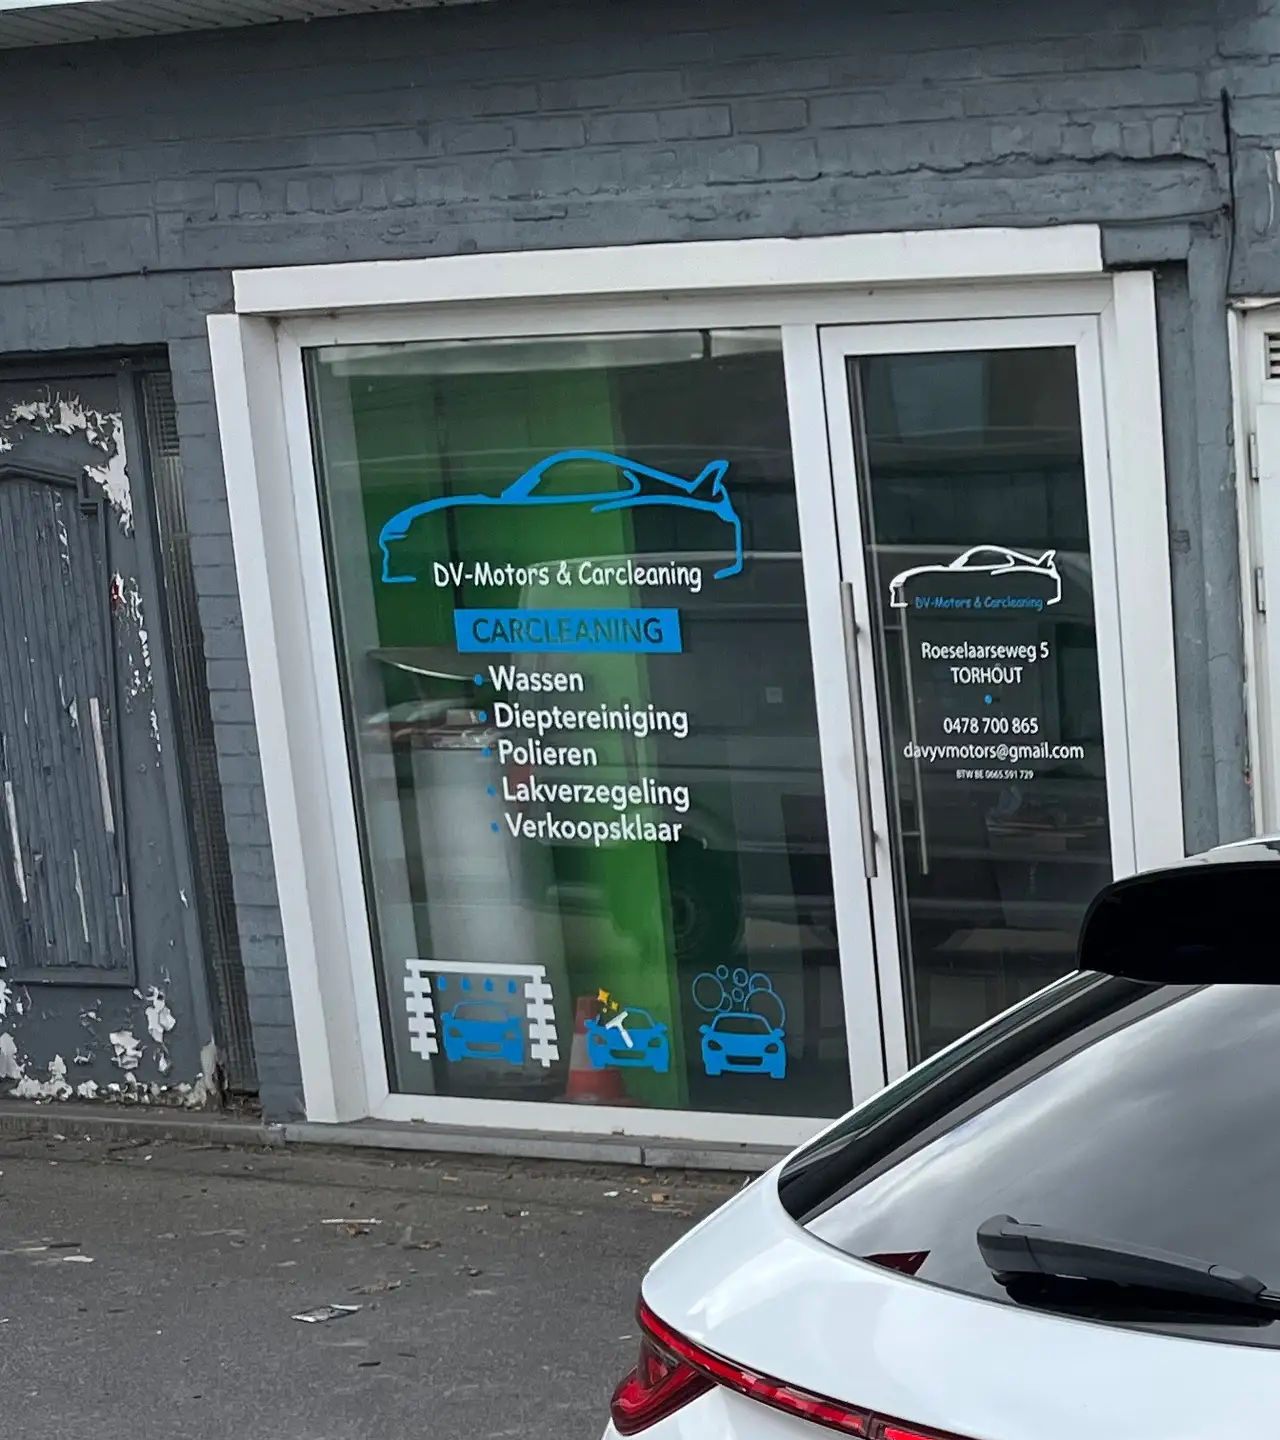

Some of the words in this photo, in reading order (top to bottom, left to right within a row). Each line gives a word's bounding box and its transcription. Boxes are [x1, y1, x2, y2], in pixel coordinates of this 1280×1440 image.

[433, 561, 550, 588] DV-Motors
[556, 562, 571, 586] &
[577, 561, 702, 593] Carcleaning
[915, 596, 971, 609] DV-Motors
[984, 596, 1043, 612] Carcleaning
[472, 617, 663, 643] CARCLEANING
[921, 641, 1037, 663] Roeselaarseweg
[1039, 641, 1050, 659] 5
[488, 665, 584, 693] Wassen
[951, 666, 1023, 684] TORHOUT
[493, 702, 690, 739] Dieptereiniging
[943, 717, 979, 734] 0478
[982, 717, 1009, 734] 700
[1012, 717, 1039, 735] 865
[498, 738, 598, 767] Polieren
[903, 741, 1085, 762] davyvmotors@gmail.com
[502, 774, 691, 813] Lakverzegeling
[504, 811, 683, 848] Verkoopsklaar
